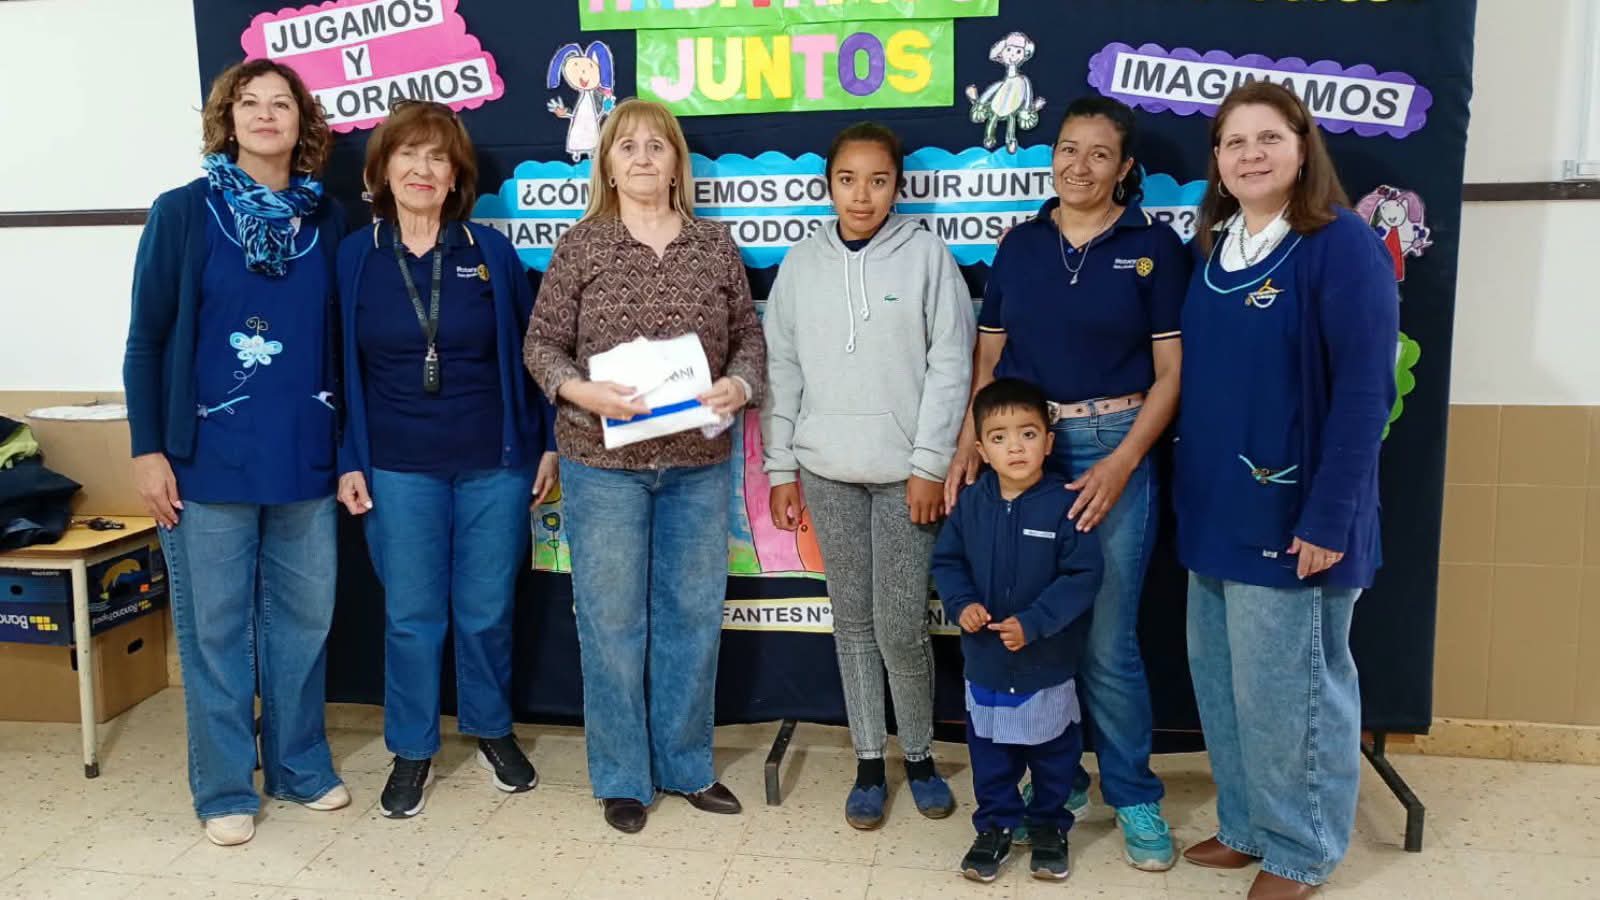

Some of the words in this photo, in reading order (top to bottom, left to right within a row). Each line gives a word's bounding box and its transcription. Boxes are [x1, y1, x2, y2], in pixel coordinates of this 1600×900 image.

[272, 0, 434, 52] JUGAMOS
[345, 47, 365, 76] Y
[651, 29, 932, 102] JUNTOS
